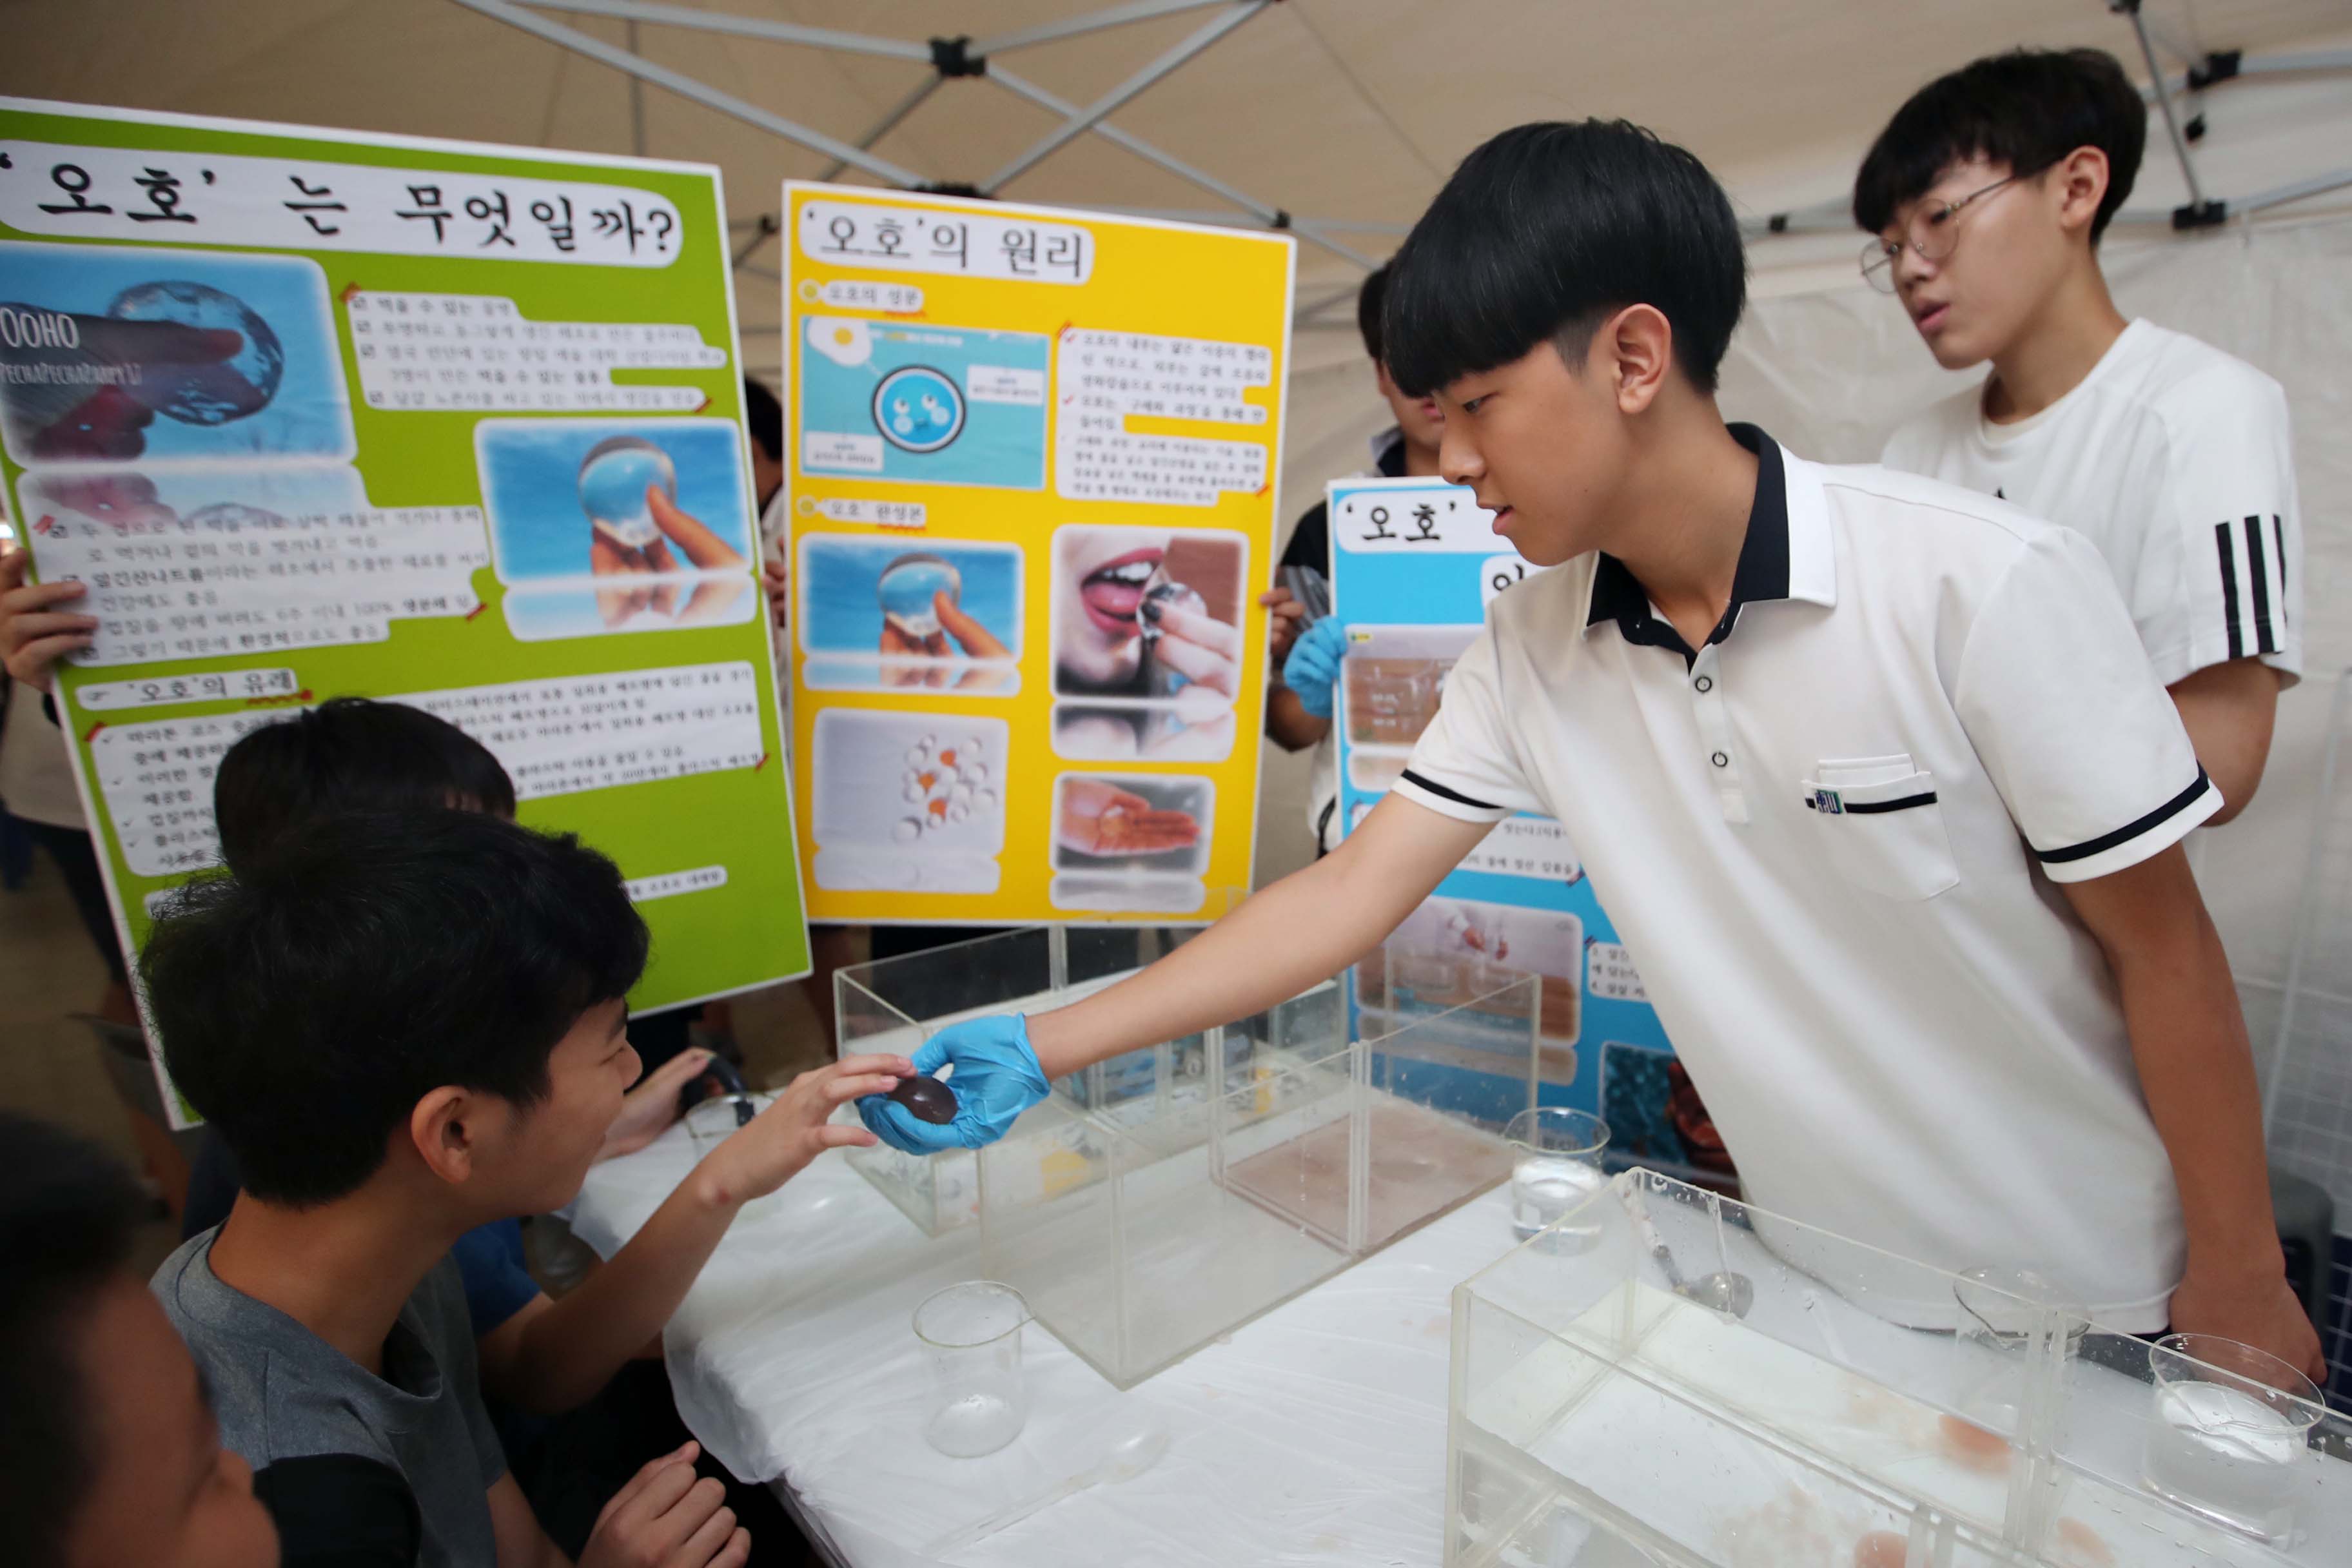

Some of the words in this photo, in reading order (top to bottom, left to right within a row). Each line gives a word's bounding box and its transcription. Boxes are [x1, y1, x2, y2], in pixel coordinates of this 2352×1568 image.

[282, 175, 349, 237] 는
[395, 184, 672, 255] 무엇일까?
[999, 227, 1084, 278] 원리
[442, 299, 472, 317] 있는
